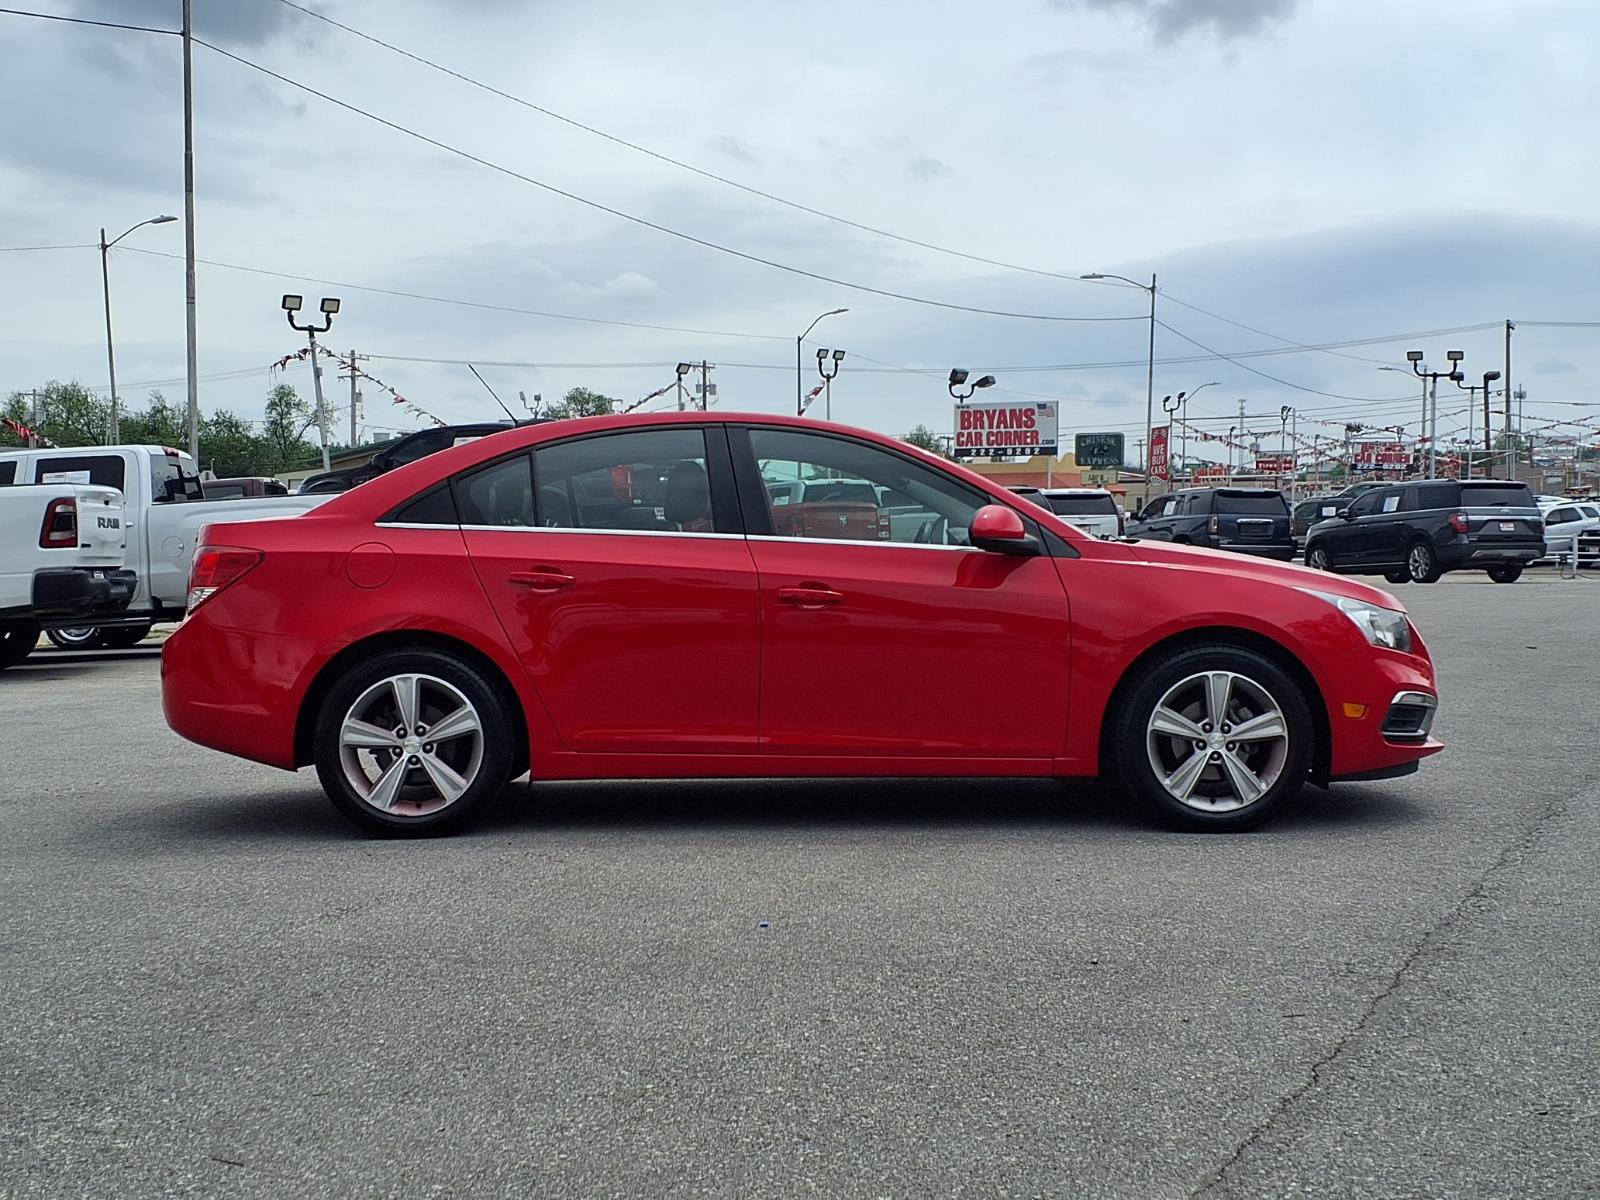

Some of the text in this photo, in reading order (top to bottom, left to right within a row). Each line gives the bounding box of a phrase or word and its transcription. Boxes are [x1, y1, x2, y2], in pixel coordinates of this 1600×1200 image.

[960, 408, 1036, 430] BRYANS
[956, 431, 984, 447] CAR
[986, 430, 1040, 446] CORNER
[1081, 436, 1117, 447] CHINESE
[1153, 444, 1165, 455] WE
[1080, 456, 1120, 465] EXPRESS
[1152, 455, 1164, 466] BUY
[1151, 465, 1167, 476] CARS
